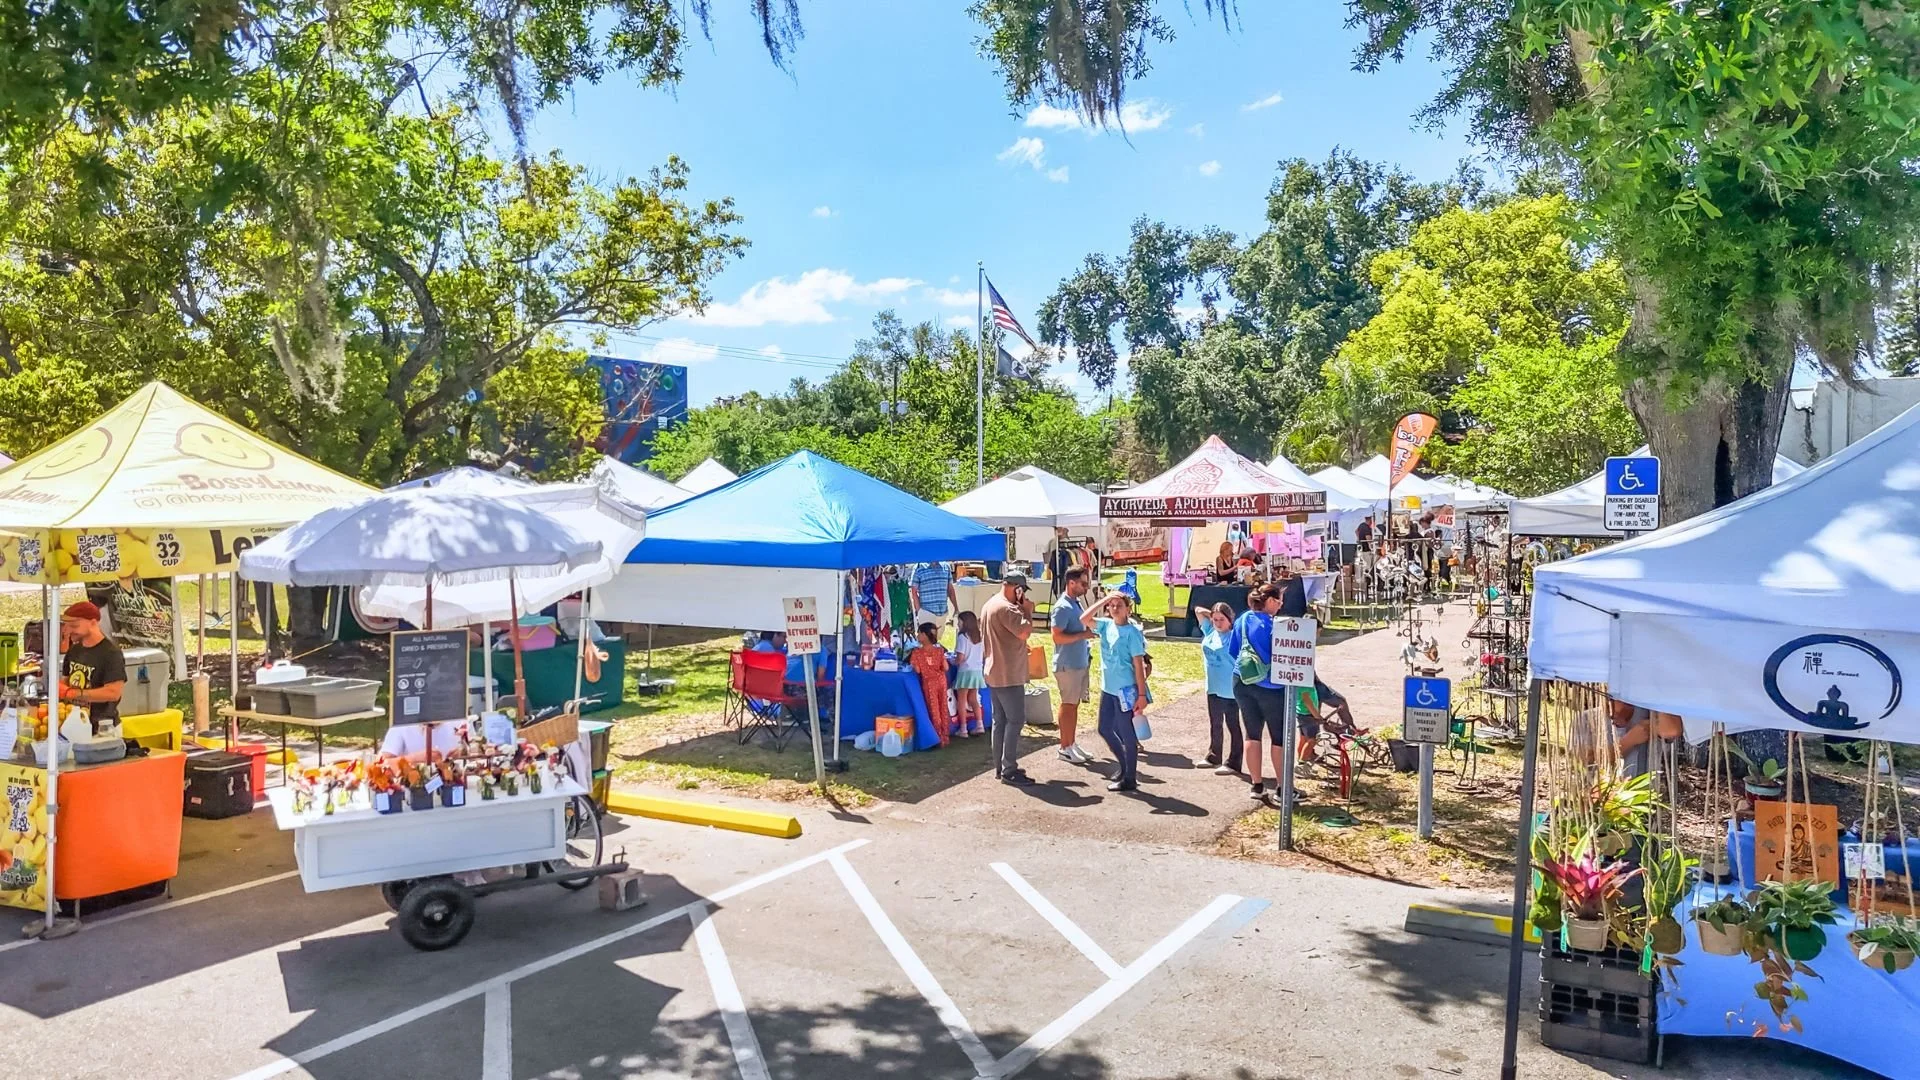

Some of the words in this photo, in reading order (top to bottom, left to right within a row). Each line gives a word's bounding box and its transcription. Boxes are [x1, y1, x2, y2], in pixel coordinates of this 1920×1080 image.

[1104, 498, 1168, 510] AYURVEDA
[1174, 496, 1259, 510] APOTHECARY
[159, 533, 174, 541] BIG
[157, 541, 180, 558] 32
[162, 558, 179, 566] CUP
[794, 601, 804, 609] NO
[787, 614, 815, 622] PARKING
[1287, 621, 1299, 632] NO
[787, 628, 818, 637] BETWEEN
[427, 642, 460, 650] PRESERVED
[794, 641, 813, 650] SIGNS
[1274, 637, 1312, 649] PARKING
[1272, 653, 1313, 666] BETWEEN
[1278, 670, 1304, 681] SIGNS
